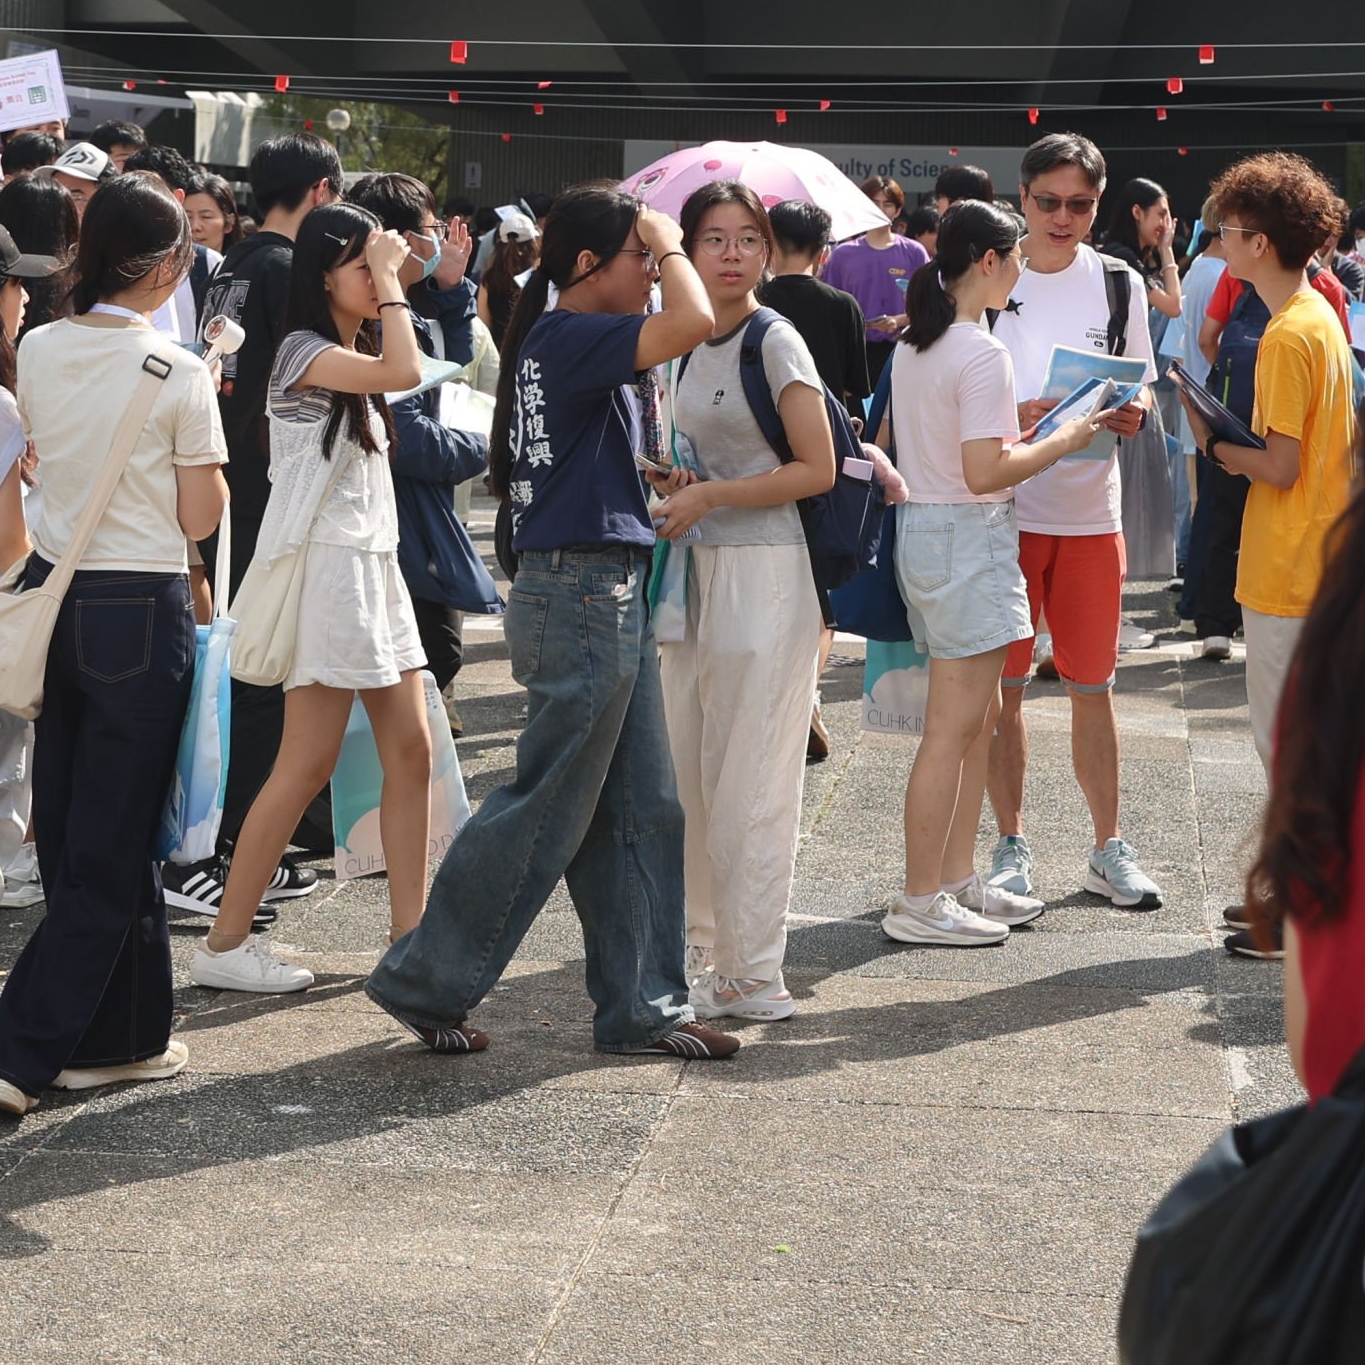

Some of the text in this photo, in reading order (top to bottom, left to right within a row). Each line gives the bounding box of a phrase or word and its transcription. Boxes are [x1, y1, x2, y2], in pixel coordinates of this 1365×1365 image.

[837, 158, 949, 179] ulty of Scien
[1085, 331, 1109, 342] GUNDA
[521, 358, 554, 469] 化学復興
[867, 708, 926, 733] CUHK IN
[344, 852, 385, 876] CUH
